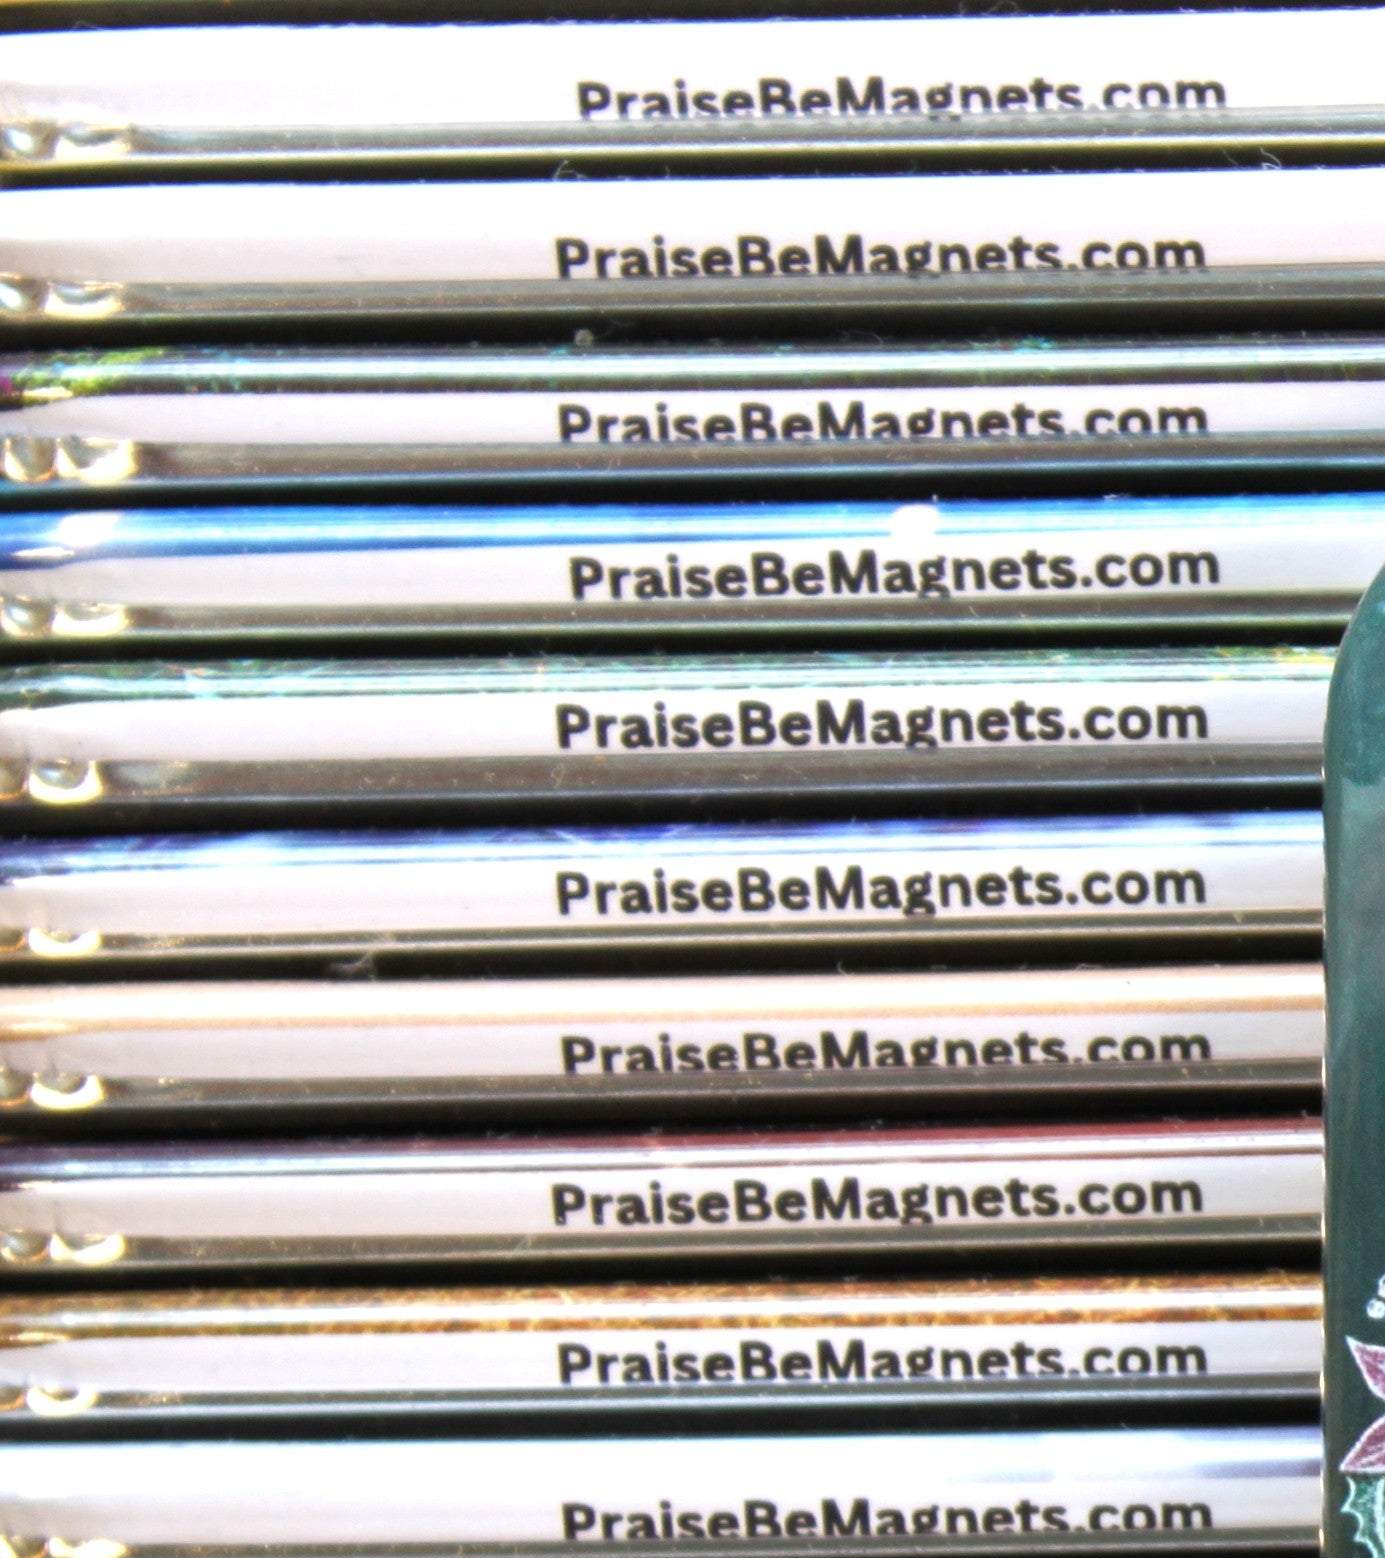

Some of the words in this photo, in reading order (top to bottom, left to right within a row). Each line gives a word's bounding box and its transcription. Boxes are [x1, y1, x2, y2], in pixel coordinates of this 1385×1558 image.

[555, 236, 1206, 279] PraiseBeMagnets.com
[570, 548, 1220, 600] PraiseBeMagnets.com
[555, 700, 1208, 750] PraiseBeMagnets.com
[555, 865, 1206, 917] PraiseBeMagnets.com
[561, 1030, 1211, 1076] PraiseBeMagnets.com
[552, 1176, 1202, 1225] PraiseBeMagnets.com
[558, 1338, 1207, 1384] PraiseBeMagnets.com
[562, 1497, 1211, 1541] PraiseBeMagnets.com
